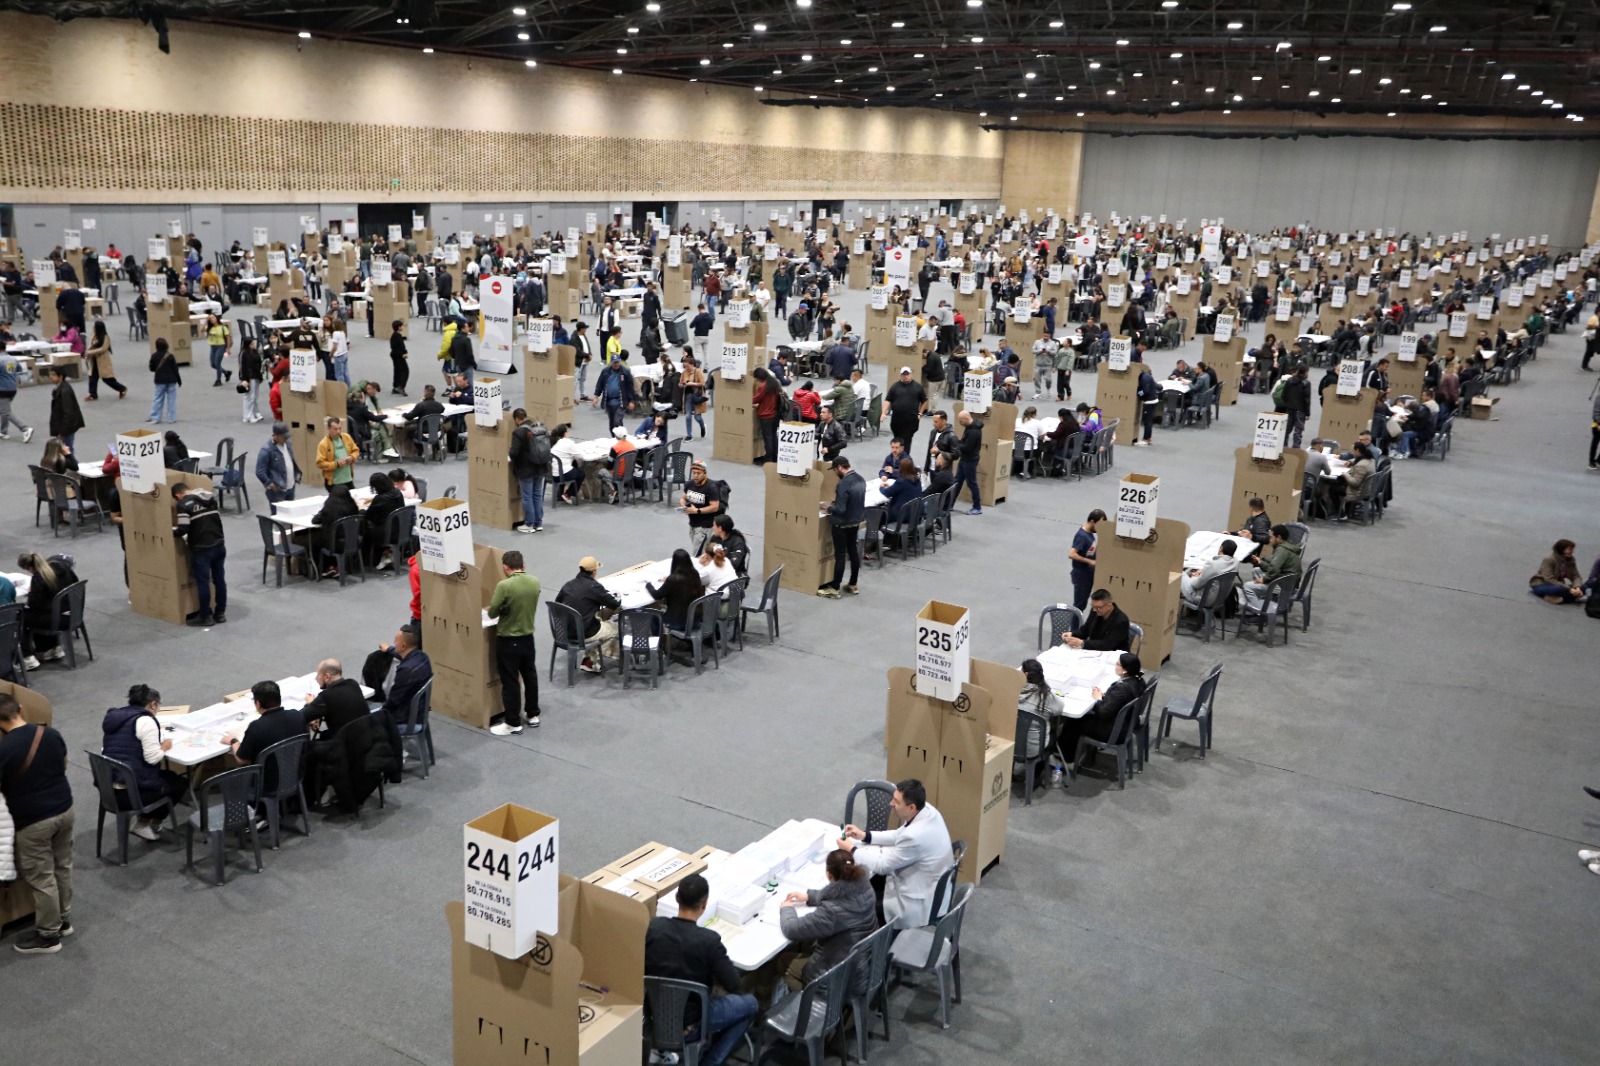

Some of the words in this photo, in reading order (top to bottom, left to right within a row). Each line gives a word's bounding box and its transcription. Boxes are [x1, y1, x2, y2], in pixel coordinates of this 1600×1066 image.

[41, 263, 54, 271] 213
[156, 277, 166, 285] 212
[872, 287, 882, 295] 202
[729, 303, 740, 311] 211
[493, 316, 509, 324] pase
[898, 320, 910, 328] 210
[1218, 316, 1231, 324] 200
[529, 322, 541, 331] 220
[1402, 335, 1416, 343] 199
[723, 346, 736, 357] 219
[737, 346, 748, 357] 219
[1111, 342, 1125, 351] 209
[293, 354, 306, 367] 229
[1341, 363, 1358, 373] 208
[965, 377, 981, 389] 218
[474, 386, 489, 399] 228
[490, 385, 502, 398] 228
[1257, 418, 1279, 431] 217
[780, 429, 800, 444] 227
[801, 429, 814, 444] 227
[118, 441, 137, 457] 237
[140, 439, 161, 457] 237
[1120, 487, 1146, 504] 226
[419, 514, 441, 532] 236
[444, 510, 469, 532] 236
[919, 627, 951, 651] 235
[466, 841, 512, 882] 244
[518, 836, 556, 884] 244
[466, 883, 512, 907] 80.778.915
